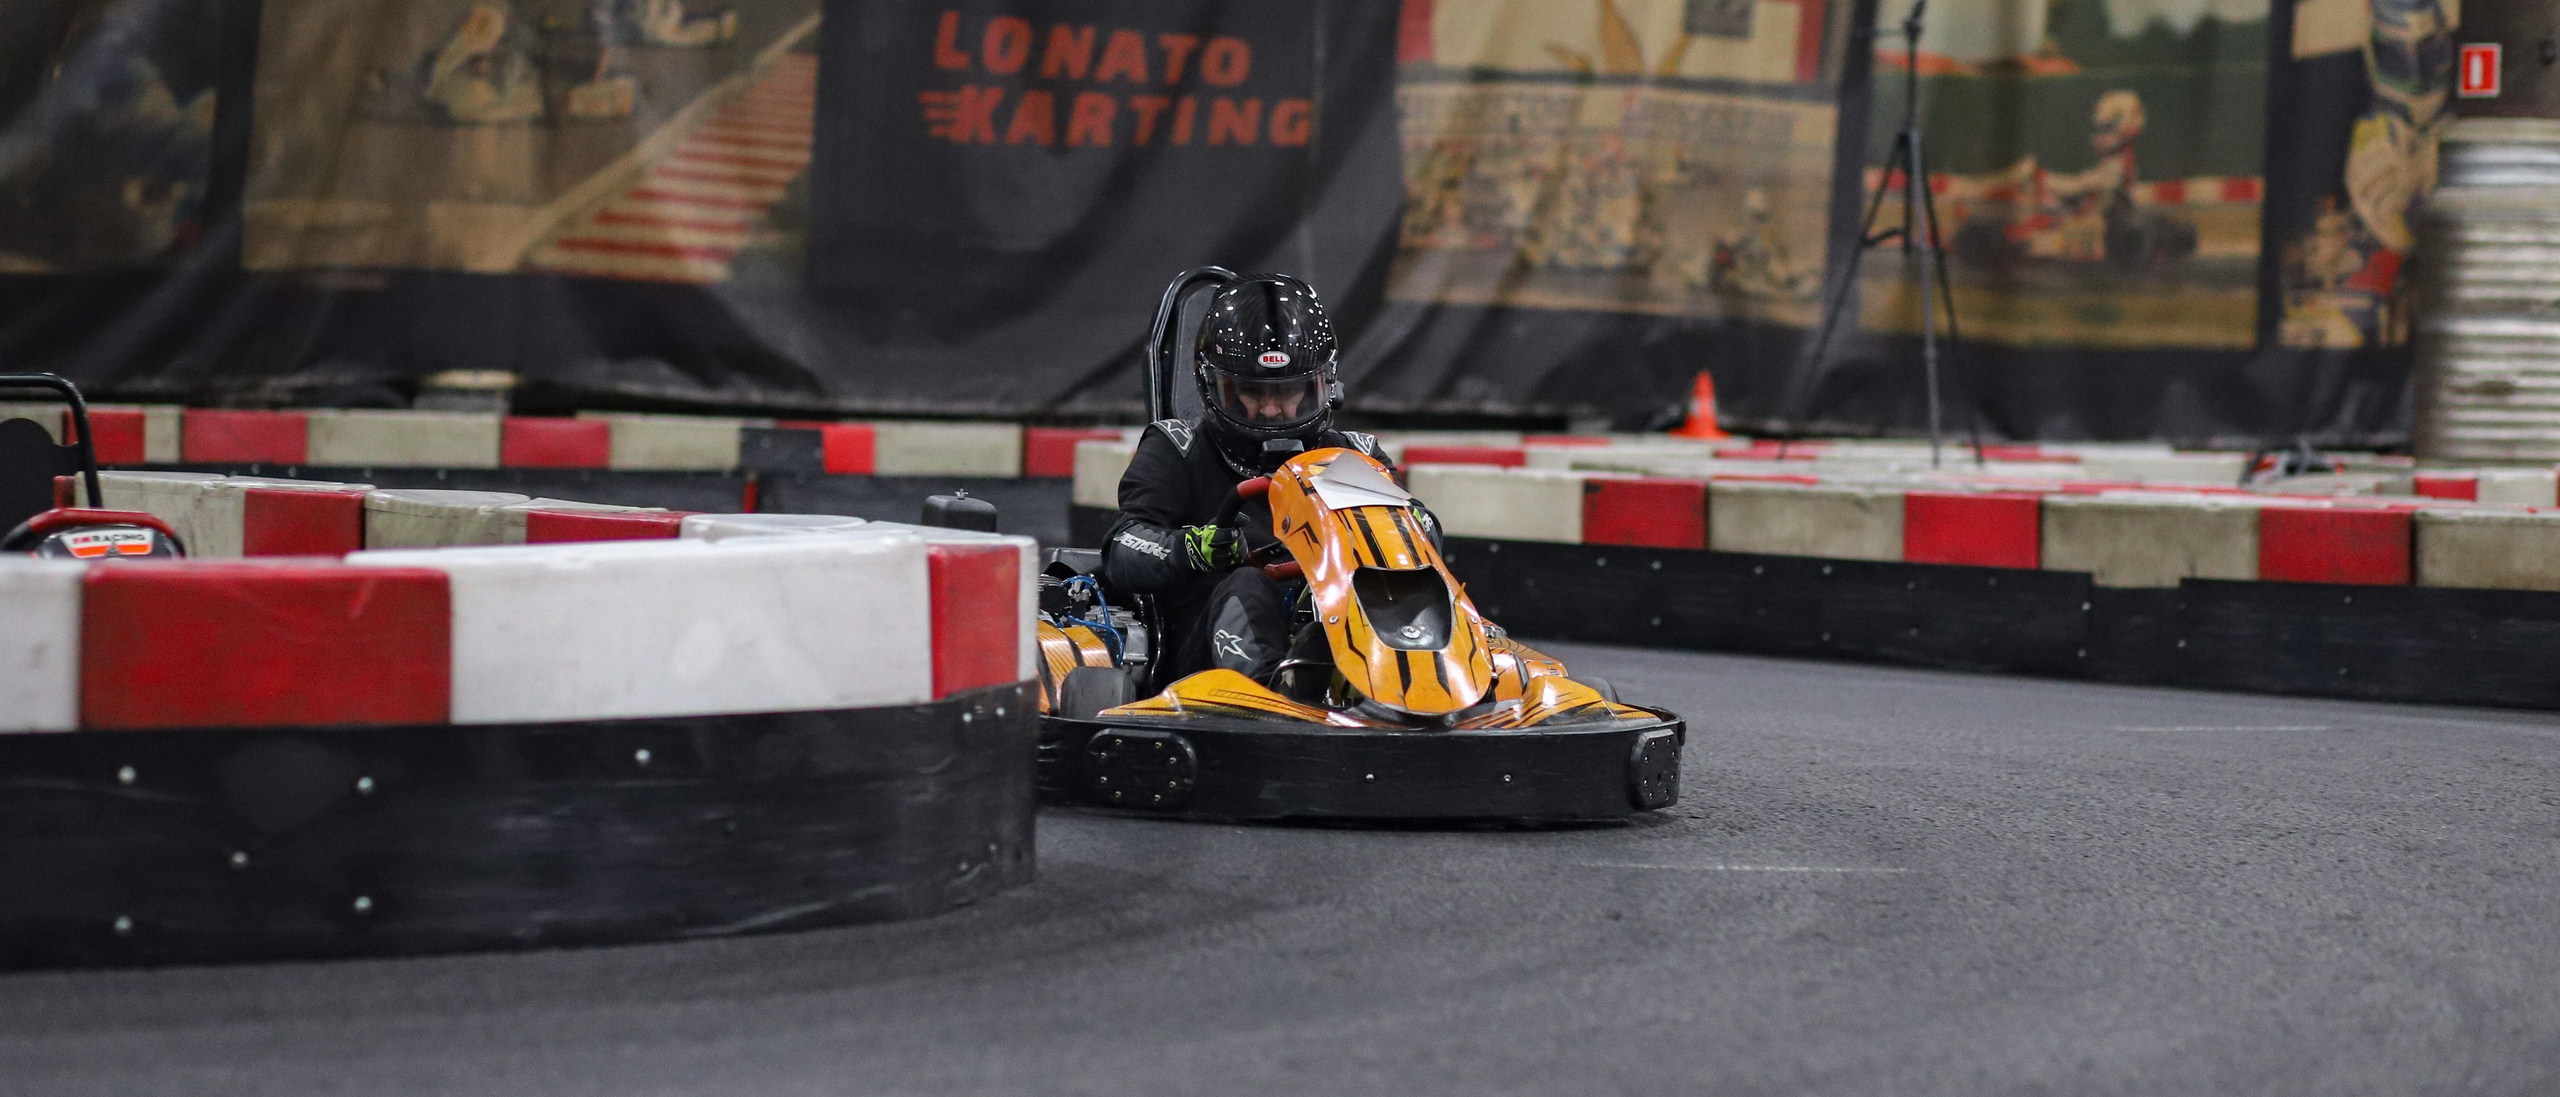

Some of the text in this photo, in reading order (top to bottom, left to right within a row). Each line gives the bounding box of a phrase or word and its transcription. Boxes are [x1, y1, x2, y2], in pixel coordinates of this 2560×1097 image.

[934, 10, 1253, 88] LONATO
[920, 84, 1312, 148] KARTING
[93, 534, 146, 542] RACING
